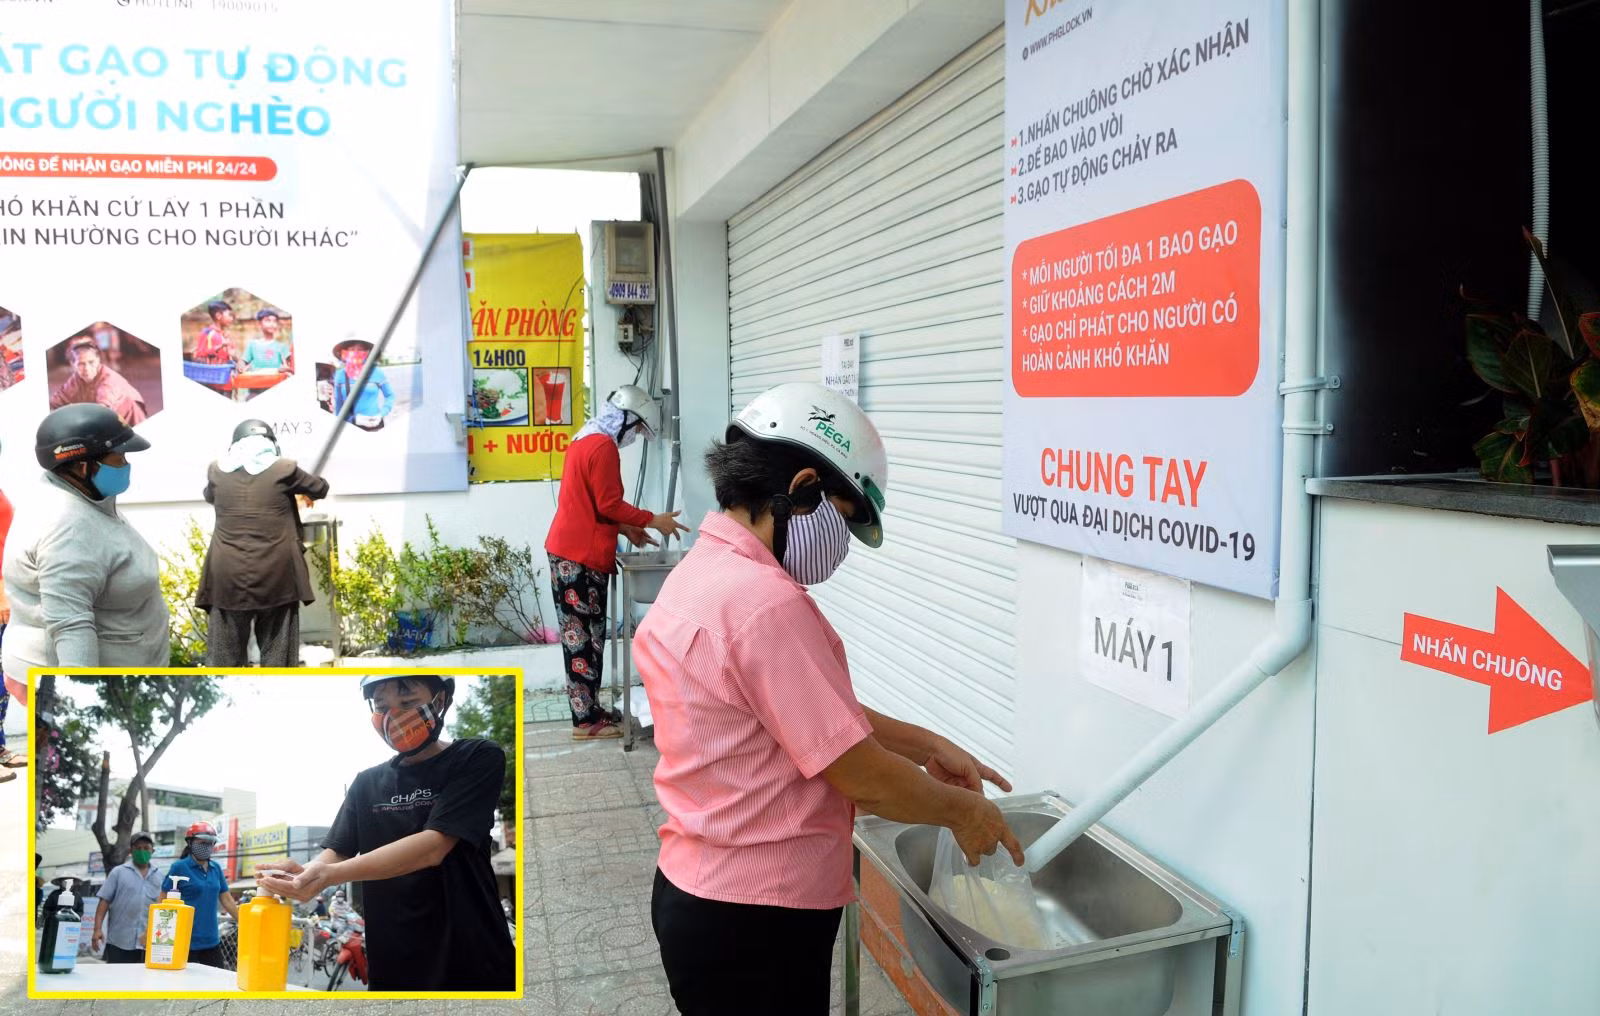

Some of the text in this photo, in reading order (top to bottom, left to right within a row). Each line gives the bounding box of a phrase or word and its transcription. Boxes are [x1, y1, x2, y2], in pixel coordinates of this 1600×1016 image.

[1030, 7, 1093, 55] WWW.PHGLOCK.VN
[58, 44, 169, 85] GẠO
[184, 45, 250, 90] TỰ
[263, 44, 407, 93] ĐỘNG
[1018, 18, 1249, 148] 1.NHẤN CHUÔNG CHỜ XÁC NHẬN
[0, 90, 331, 136] GƯỜI NGHÈO
[1044, 139, 1067, 166] BAO
[1070, 126, 1096, 154] VÀO
[1100, 113, 1123, 141] VÒI
[0, 155, 35, 172] ÔNG
[62, 156, 107, 175] NHẬN
[110, 159, 143, 175] GẠO
[187, 159, 213, 175] PHÍ
[216, 161, 257, 176] 24/24
[1017, 127, 1178, 205] 3.GẠO TỰ ĐỘNG CHẢY RA
[32, 194, 99, 217] KHĂN
[107, 194, 143, 217] CỨ
[200, 202, 208, 218] 1
[0, 228, 26, 245] IN
[35, 223, 140, 246] NHƯỜNG
[147, 229, 197, 246] CHO
[205, 226, 279, 247] NGƯỜI
[1053, 250, 1093, 280] NGƯỜI
[1096, 242, 1118, 272] TỐI
[1121, 245, 1142, 267] ĐA
[1146, 240, 1153, 261] 1
[1159, 230, 1193, 259] BAO
[1199, 220, 1238, 252] GẠO
[1052, 279, 1104, 311] KHOẢNG
[1107, 275, 1147, 302] CÁCH
[1152, 270, 1176, 296] 2M
[471, 301, 577, 336] ĂN PHÒNG
[1029, 292, 1238, 347] GẠO CHỈ PHÁT CHO NGƯỜI CÓ
[473, 349, 526, 366] 14H00
[1022, 338, 1170, 373] HOÀN CẢNH KHÓ KHĂN
[304, 420, 313, 434] 3
[483, 440, 498, 453] +
[507, 430, 569, 454] NƯỚC
[815, 421, 852, 453] PEGA
[1040, 447, 1207, 508] CHUNG TAY
[1013, 492, 1256, 561] VƯỢT QUA ĐẠI DỊCH COVID-19
[1094, 617, 1173, 681] MÁY 1
[1413, 634, 1563, 691] NHẤN CHUÔNG
[390, 788, 432, 804] CHAPS
